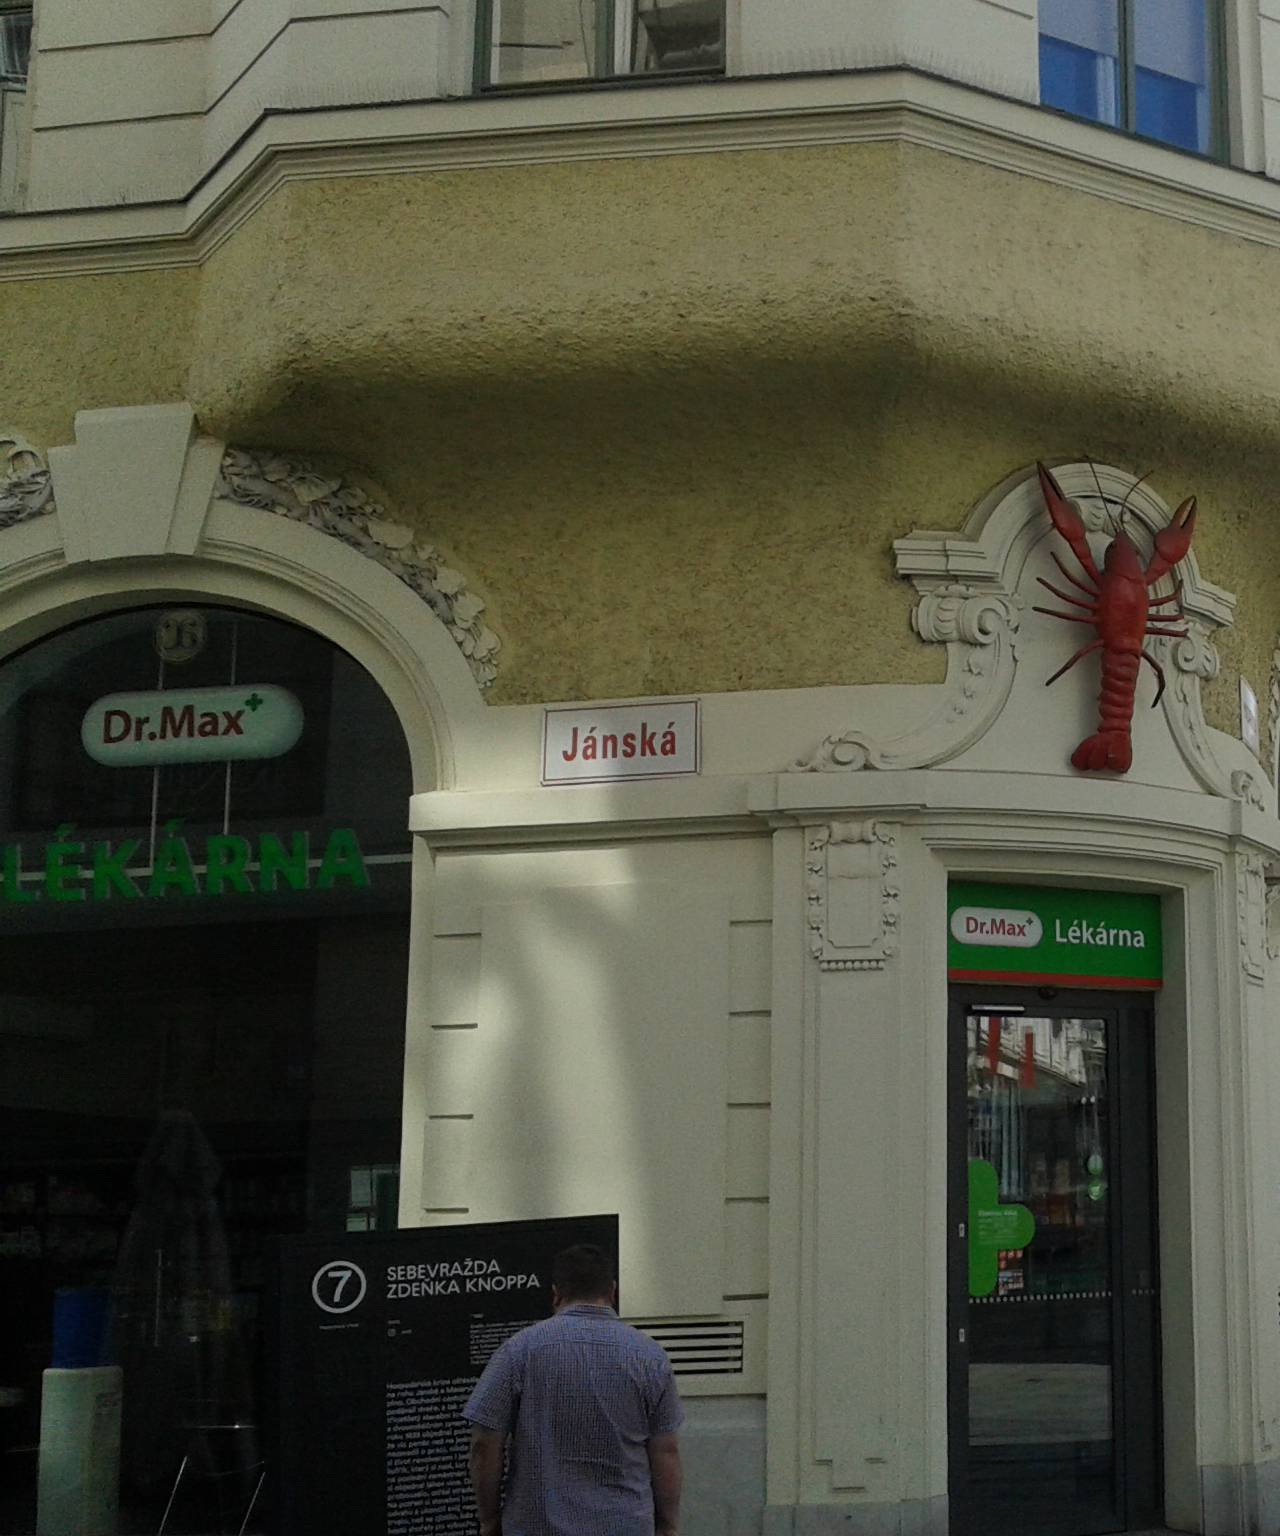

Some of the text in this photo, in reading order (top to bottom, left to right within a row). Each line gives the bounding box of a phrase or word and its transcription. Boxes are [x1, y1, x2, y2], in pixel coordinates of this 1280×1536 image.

[103, 704, 245, 744] Dr.Max
[562, 720, 678, 762] Jánská
[1, 818, 372, 902] LÉKÁRNA
[965, 917, 1145, 948] Dr.Max Lékárna
[388, 1258, 500, 1280] SEBEVRAŽDA
[327, 1270, 353, 1303] 7
[388, 1274, 540, 1298] ZDEŇKA KNOPPA
